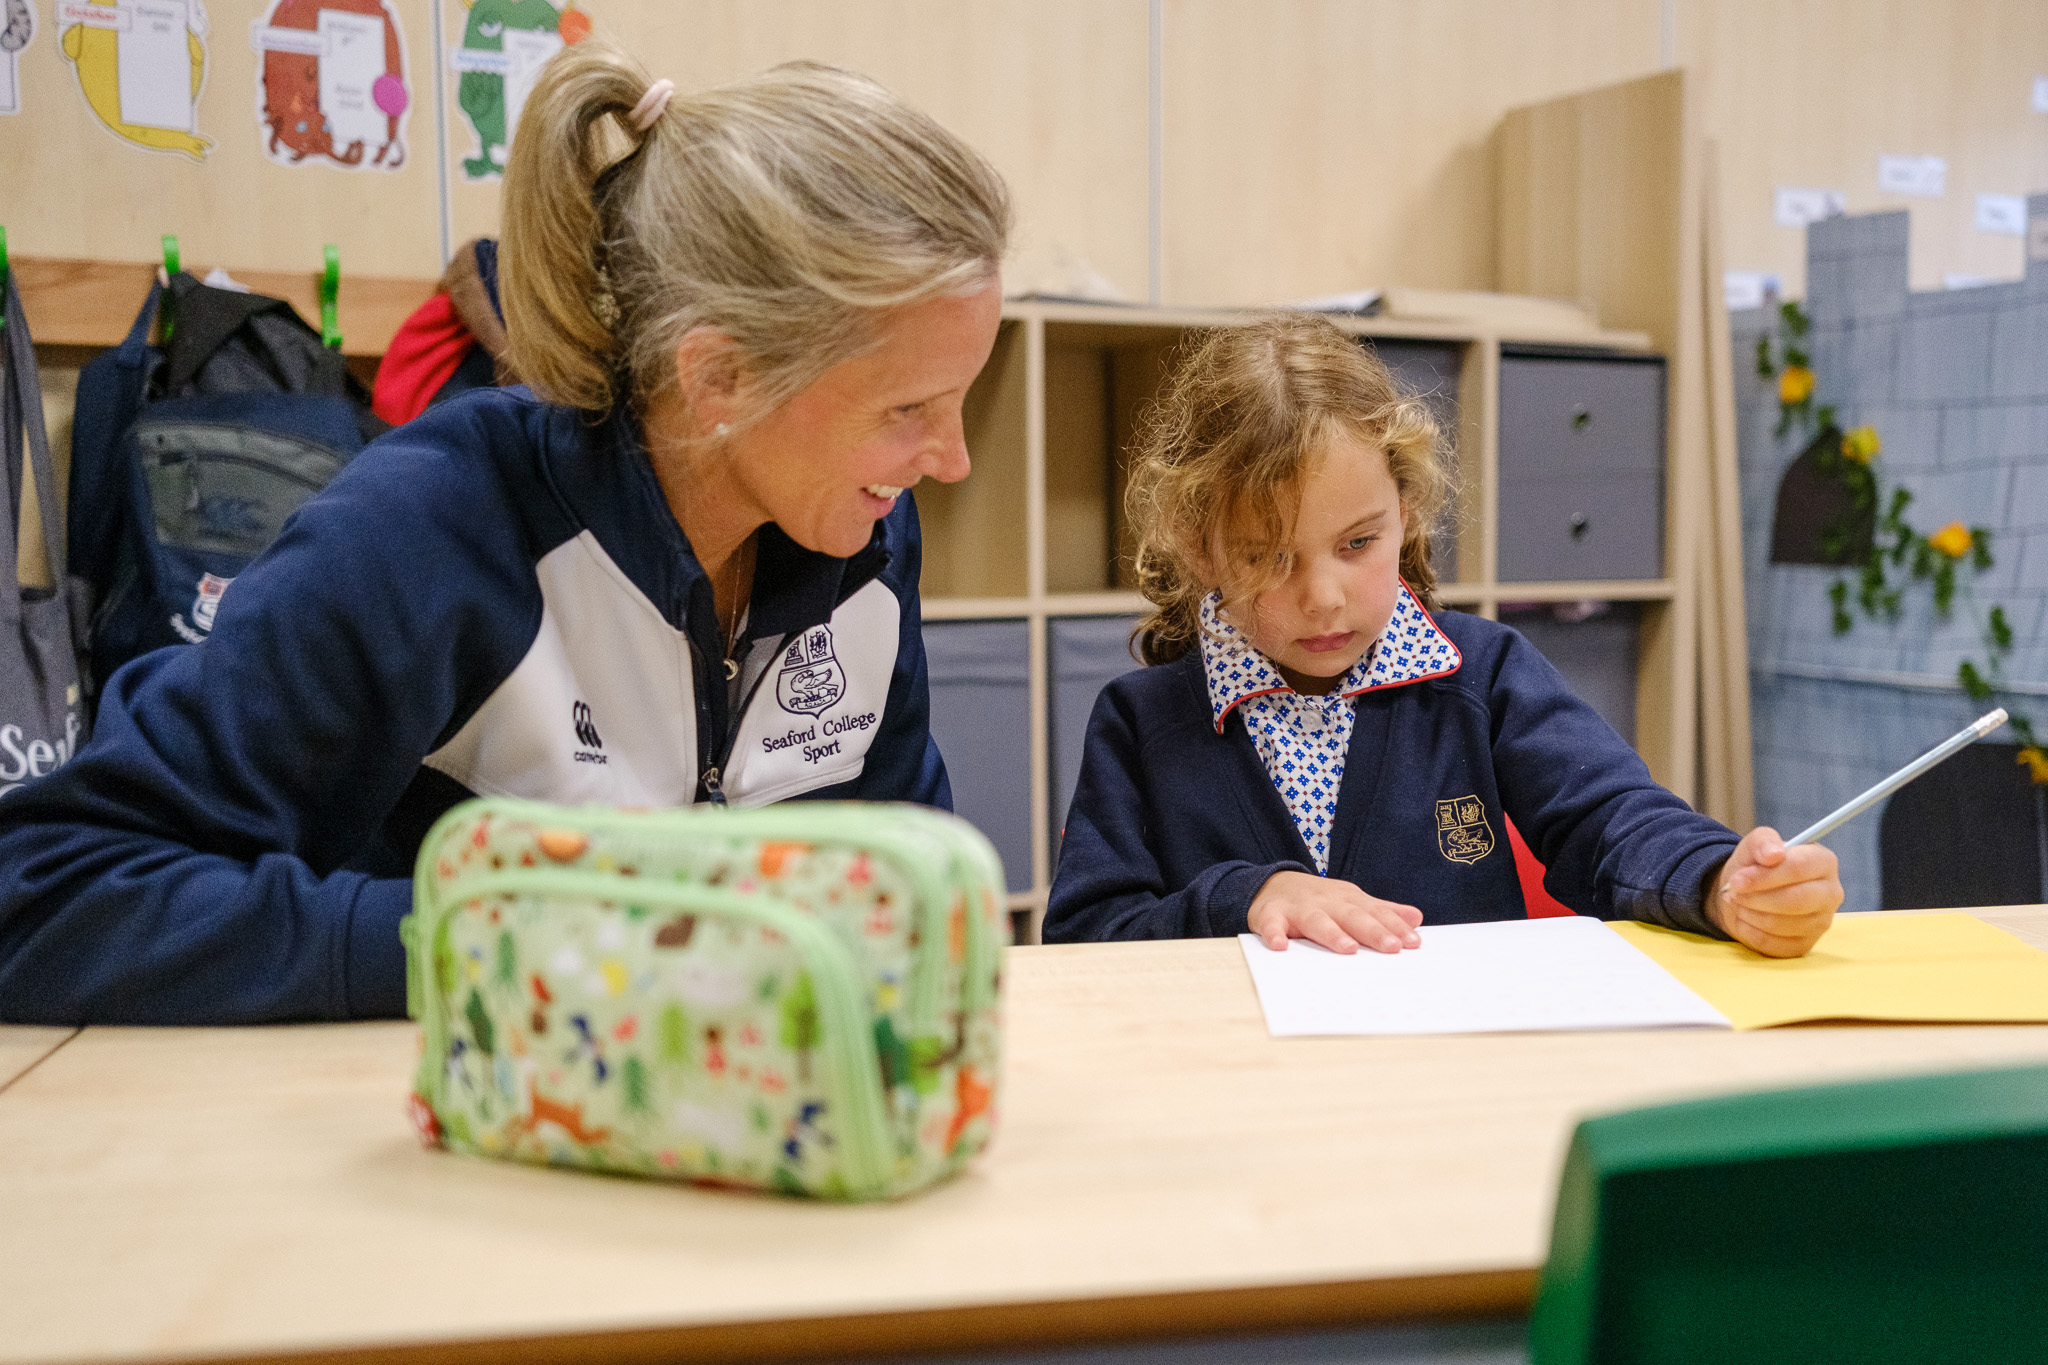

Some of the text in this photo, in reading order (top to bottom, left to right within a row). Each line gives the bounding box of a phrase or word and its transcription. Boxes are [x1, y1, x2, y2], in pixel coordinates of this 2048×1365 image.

[762, 712, 877, 753] Seaford College
[803, 739, 841, 764] Sport
